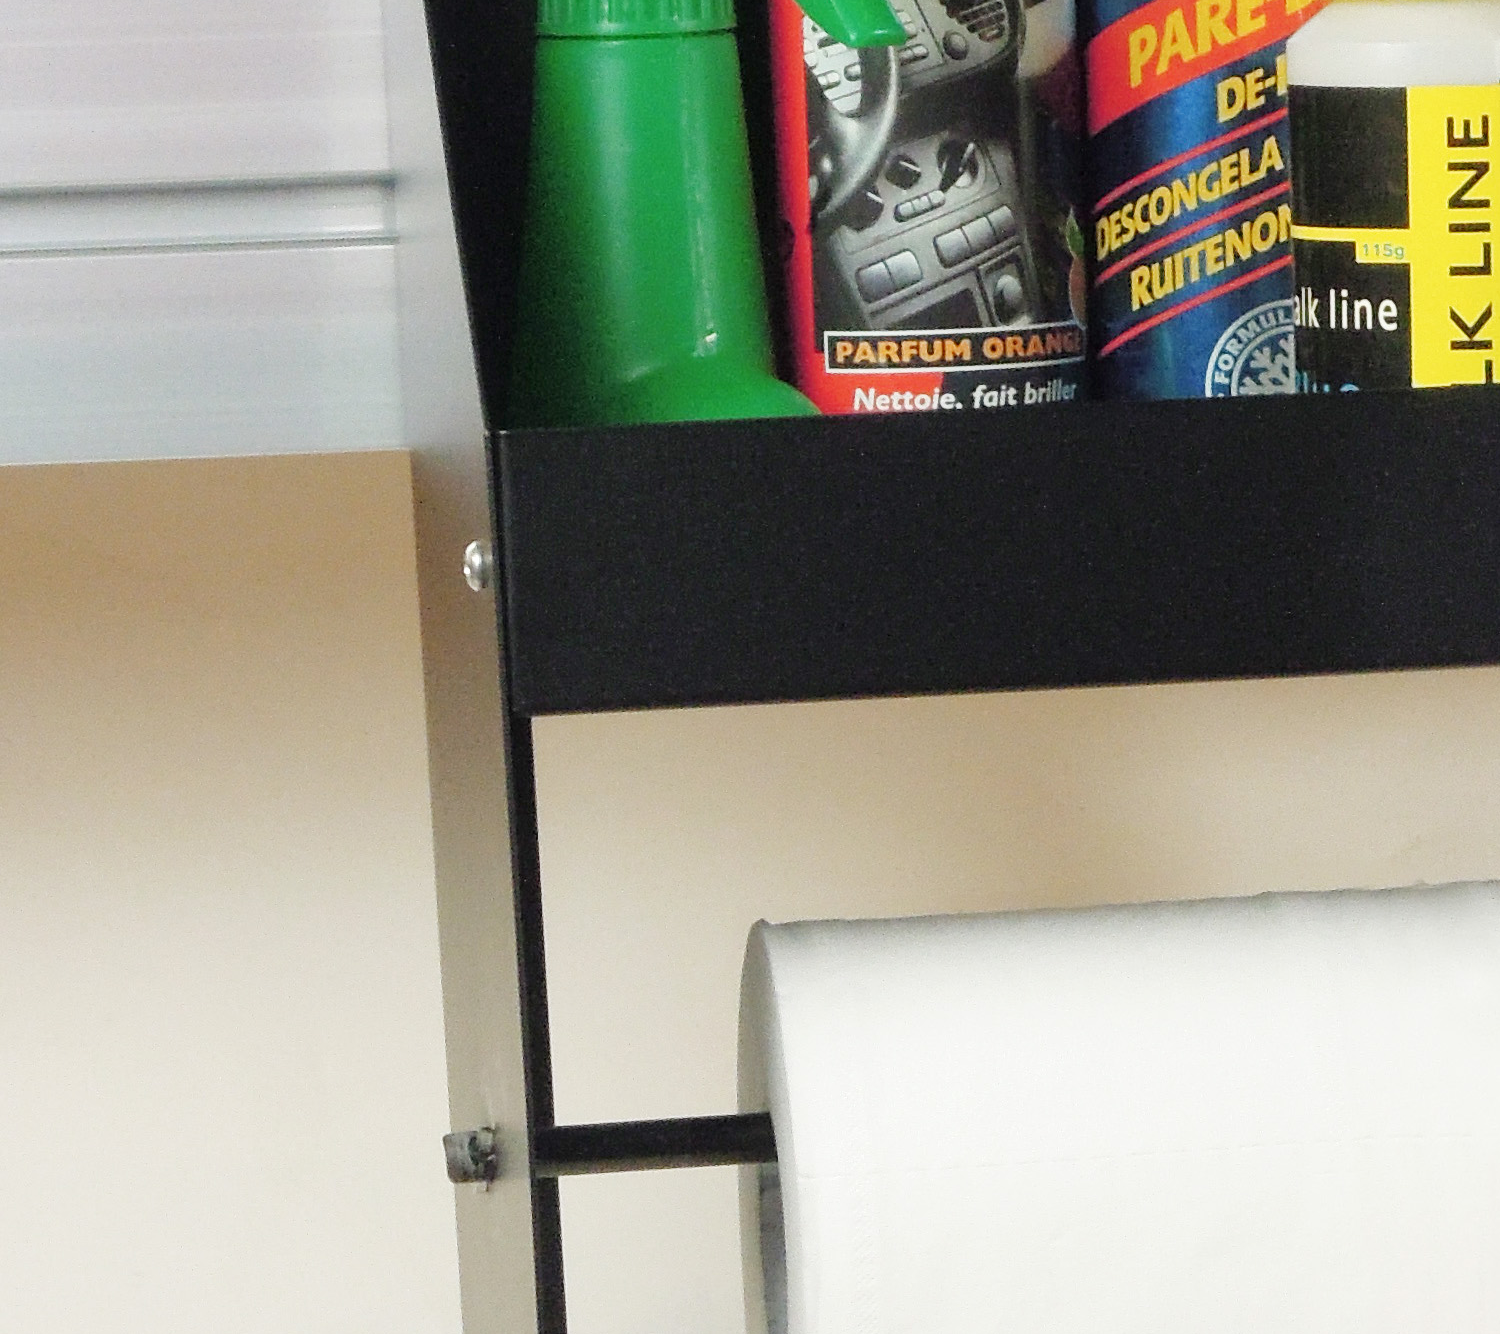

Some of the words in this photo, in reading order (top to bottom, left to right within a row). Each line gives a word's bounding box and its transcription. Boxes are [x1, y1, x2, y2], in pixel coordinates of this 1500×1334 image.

[1096, 135, 1284, 262] DESCONGELA
[1447, 114, 1492, 277] LINE
[1362, 243, 1405, 259] 115g
[1329, 288, 1398, 331] line
[835, 336, 972, 365] PARFUM
[972, 384, 1018, 409] fait
[1024, 379, 1076, 405] briller
